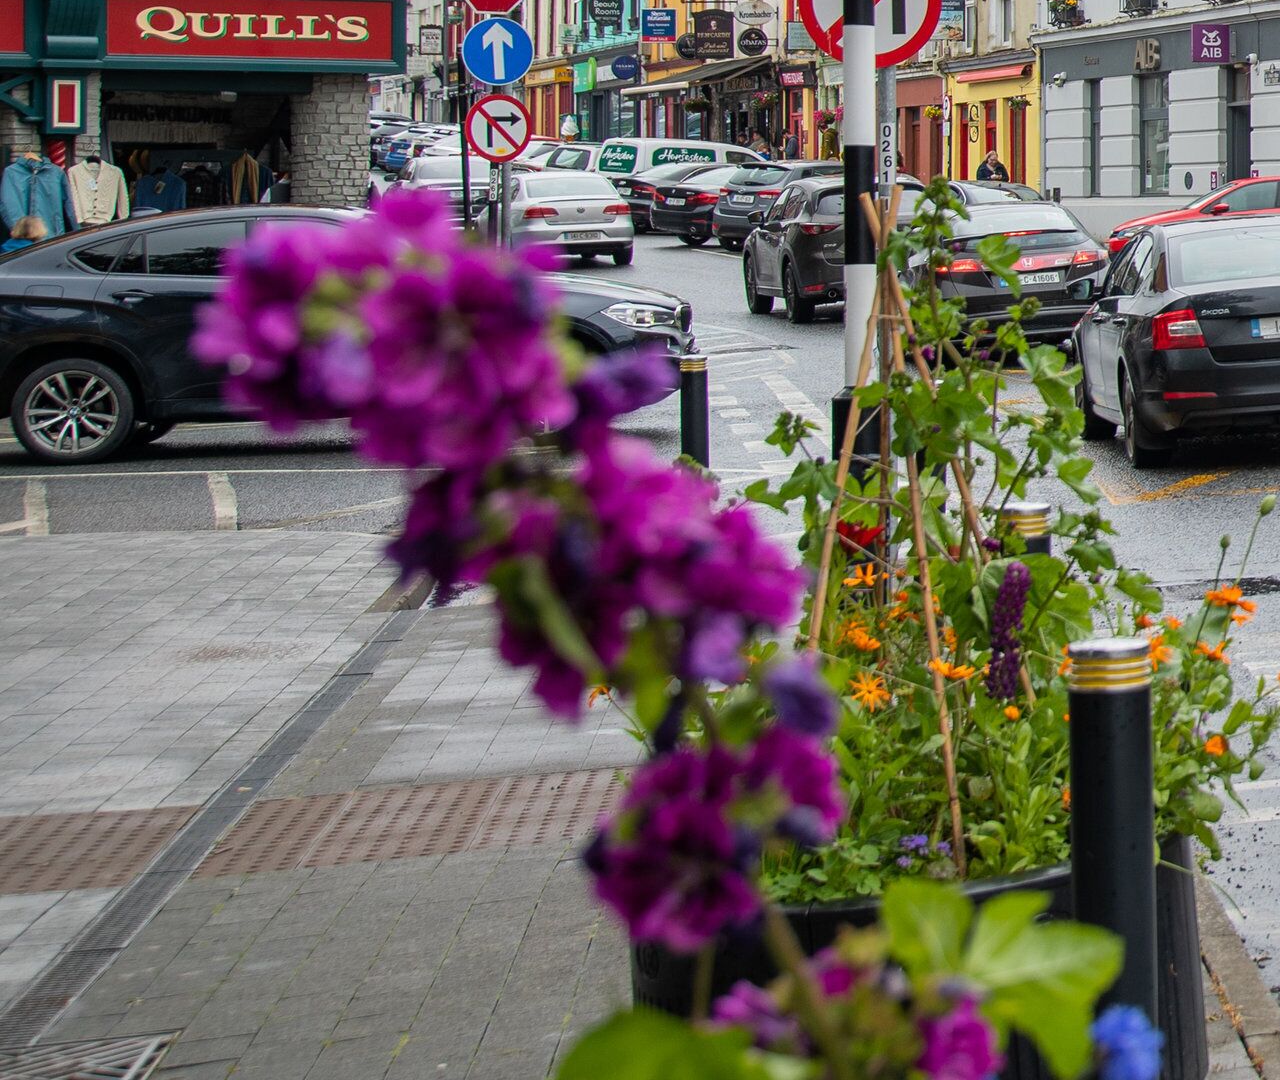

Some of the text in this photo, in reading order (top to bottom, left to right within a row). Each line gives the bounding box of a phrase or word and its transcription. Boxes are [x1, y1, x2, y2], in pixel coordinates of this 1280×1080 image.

[593, 0, 618, 10] Beauty
[595, 8, 621, 16] Rooms
[739, 10, 772, 19] Krombacher
[135, 5, 370, 42] QUILL'S
[1133, 38, 1161, 71] AIB
[1200, 48, 1222, 58] AIB
[657, 149, 712, 162] Horseshoe
[881, 125, 893, 183] 0261
